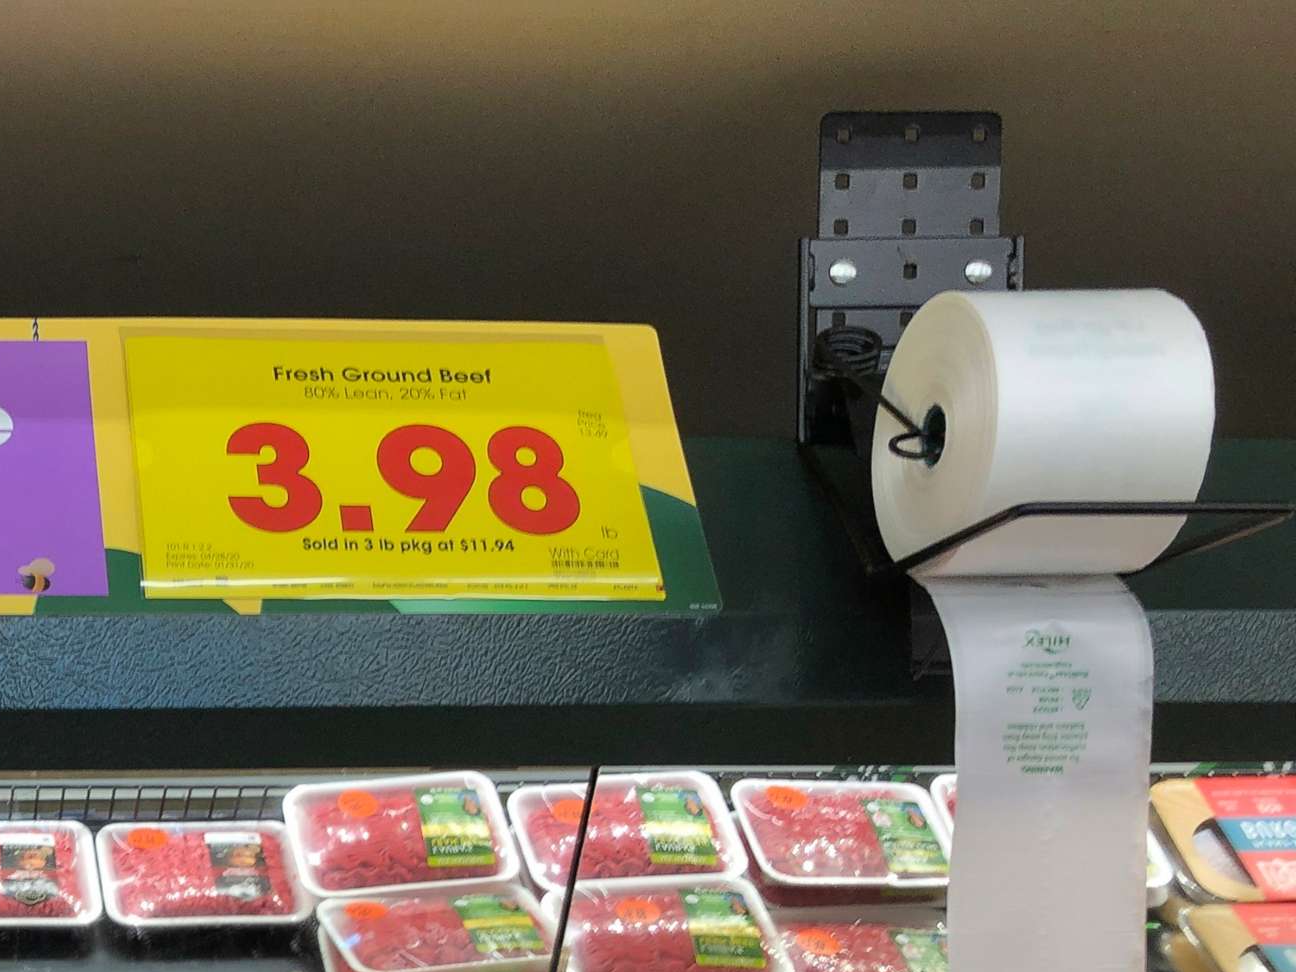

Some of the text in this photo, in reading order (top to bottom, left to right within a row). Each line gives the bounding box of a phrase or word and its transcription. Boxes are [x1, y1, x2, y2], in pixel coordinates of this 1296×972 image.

[272, 366, 491, 384] Fresh Ground Beef
[304, 386, 339, 400] 80%
[400, 388, 435, 400] 20%
[440, 388, 466, 400] Fat
[226, 422, 581, 535] 3.98
[601, 526, 618, 540] lb
[302, 538, 514, 555] Sold in 3 lb pkg at $11.94
[548, 548, 619, 560] With Card
